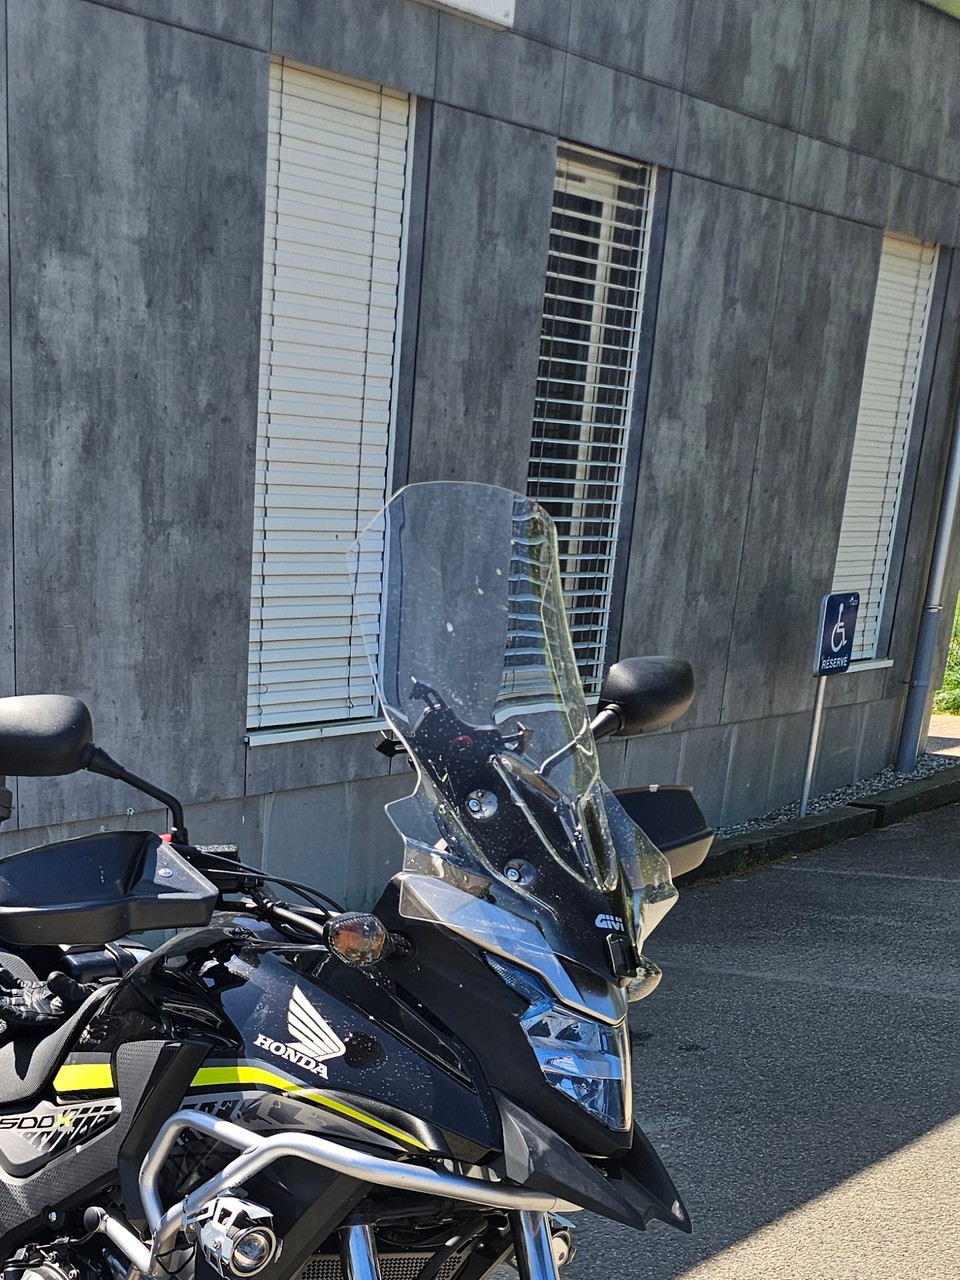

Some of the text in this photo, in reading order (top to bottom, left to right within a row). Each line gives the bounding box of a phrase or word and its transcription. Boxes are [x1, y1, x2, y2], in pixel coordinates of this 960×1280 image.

[821, 654, 848, 669] RÉSERVÉ
[595, 913, 625, 932] GIVI
[253, 1033, 328, 1080] HONDA
